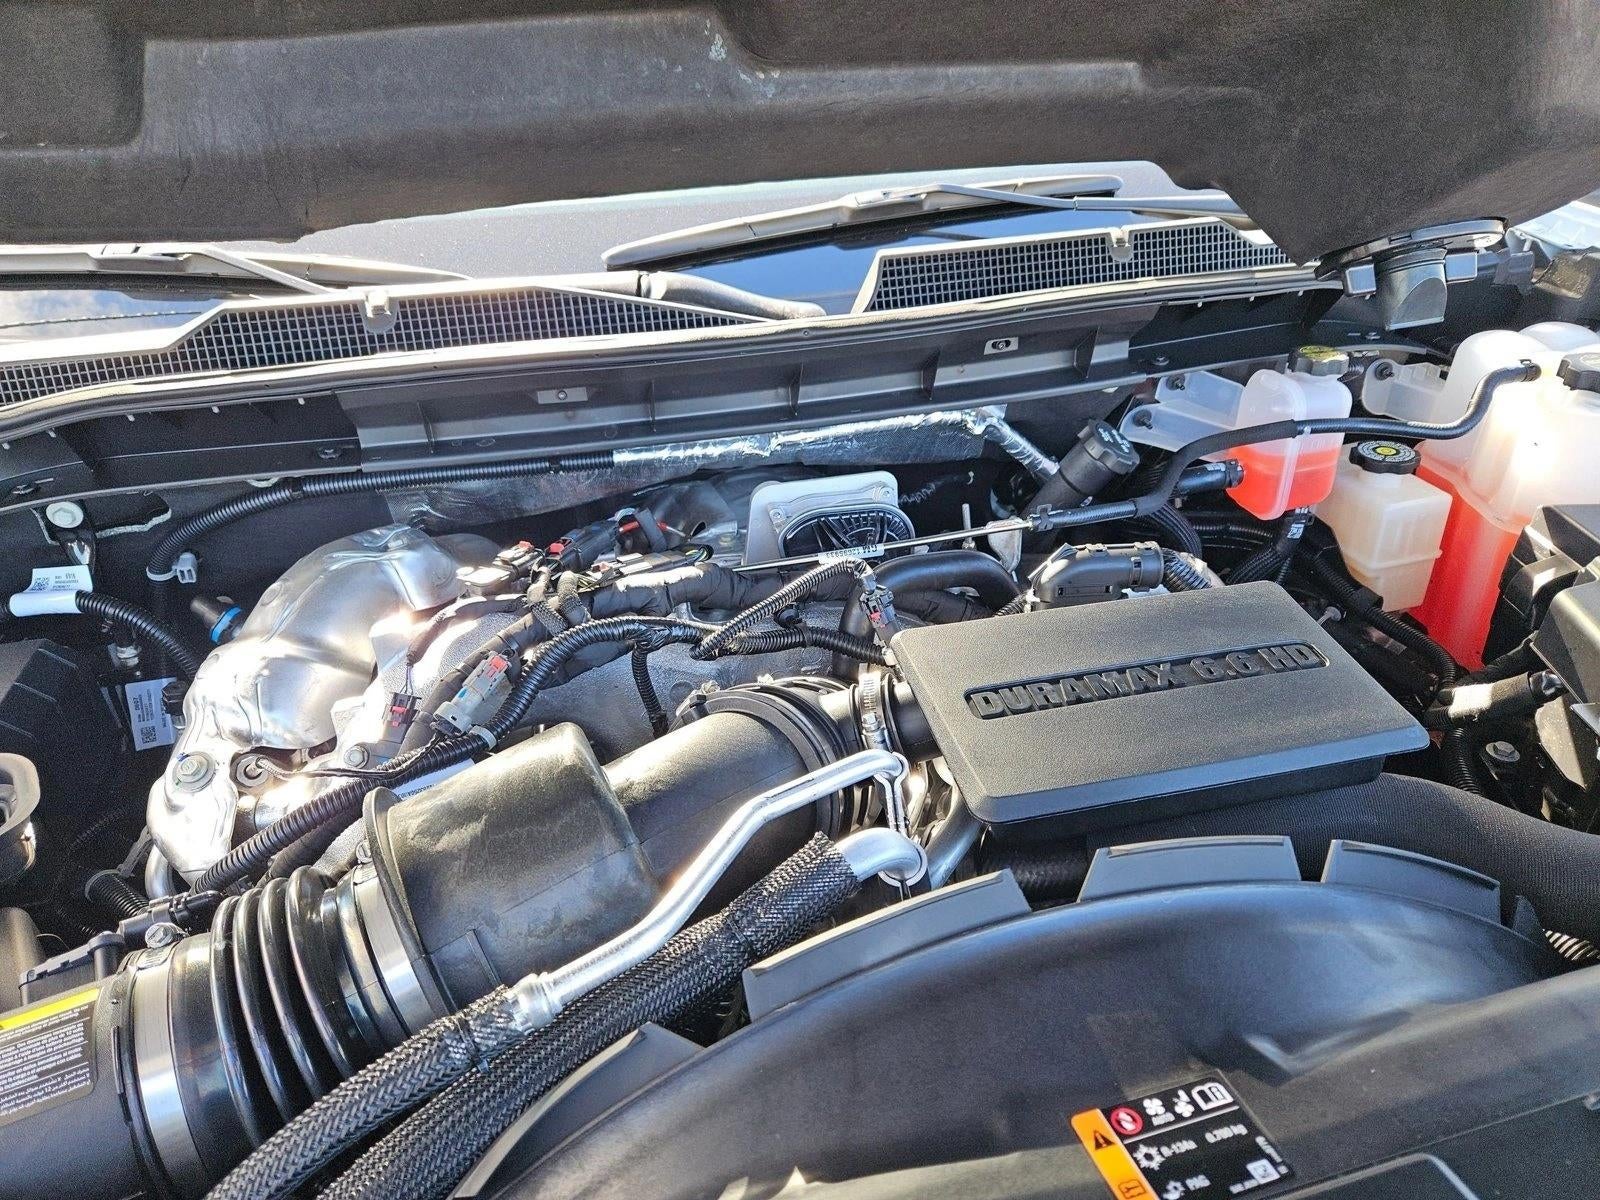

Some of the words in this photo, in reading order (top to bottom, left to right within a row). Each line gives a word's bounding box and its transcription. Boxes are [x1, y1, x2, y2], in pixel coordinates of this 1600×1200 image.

[970, 662, 1185, 718] DURAMAX
[1190, 652, 1261, 682] 6.6
[1258, 643, 1320, 673] HD
